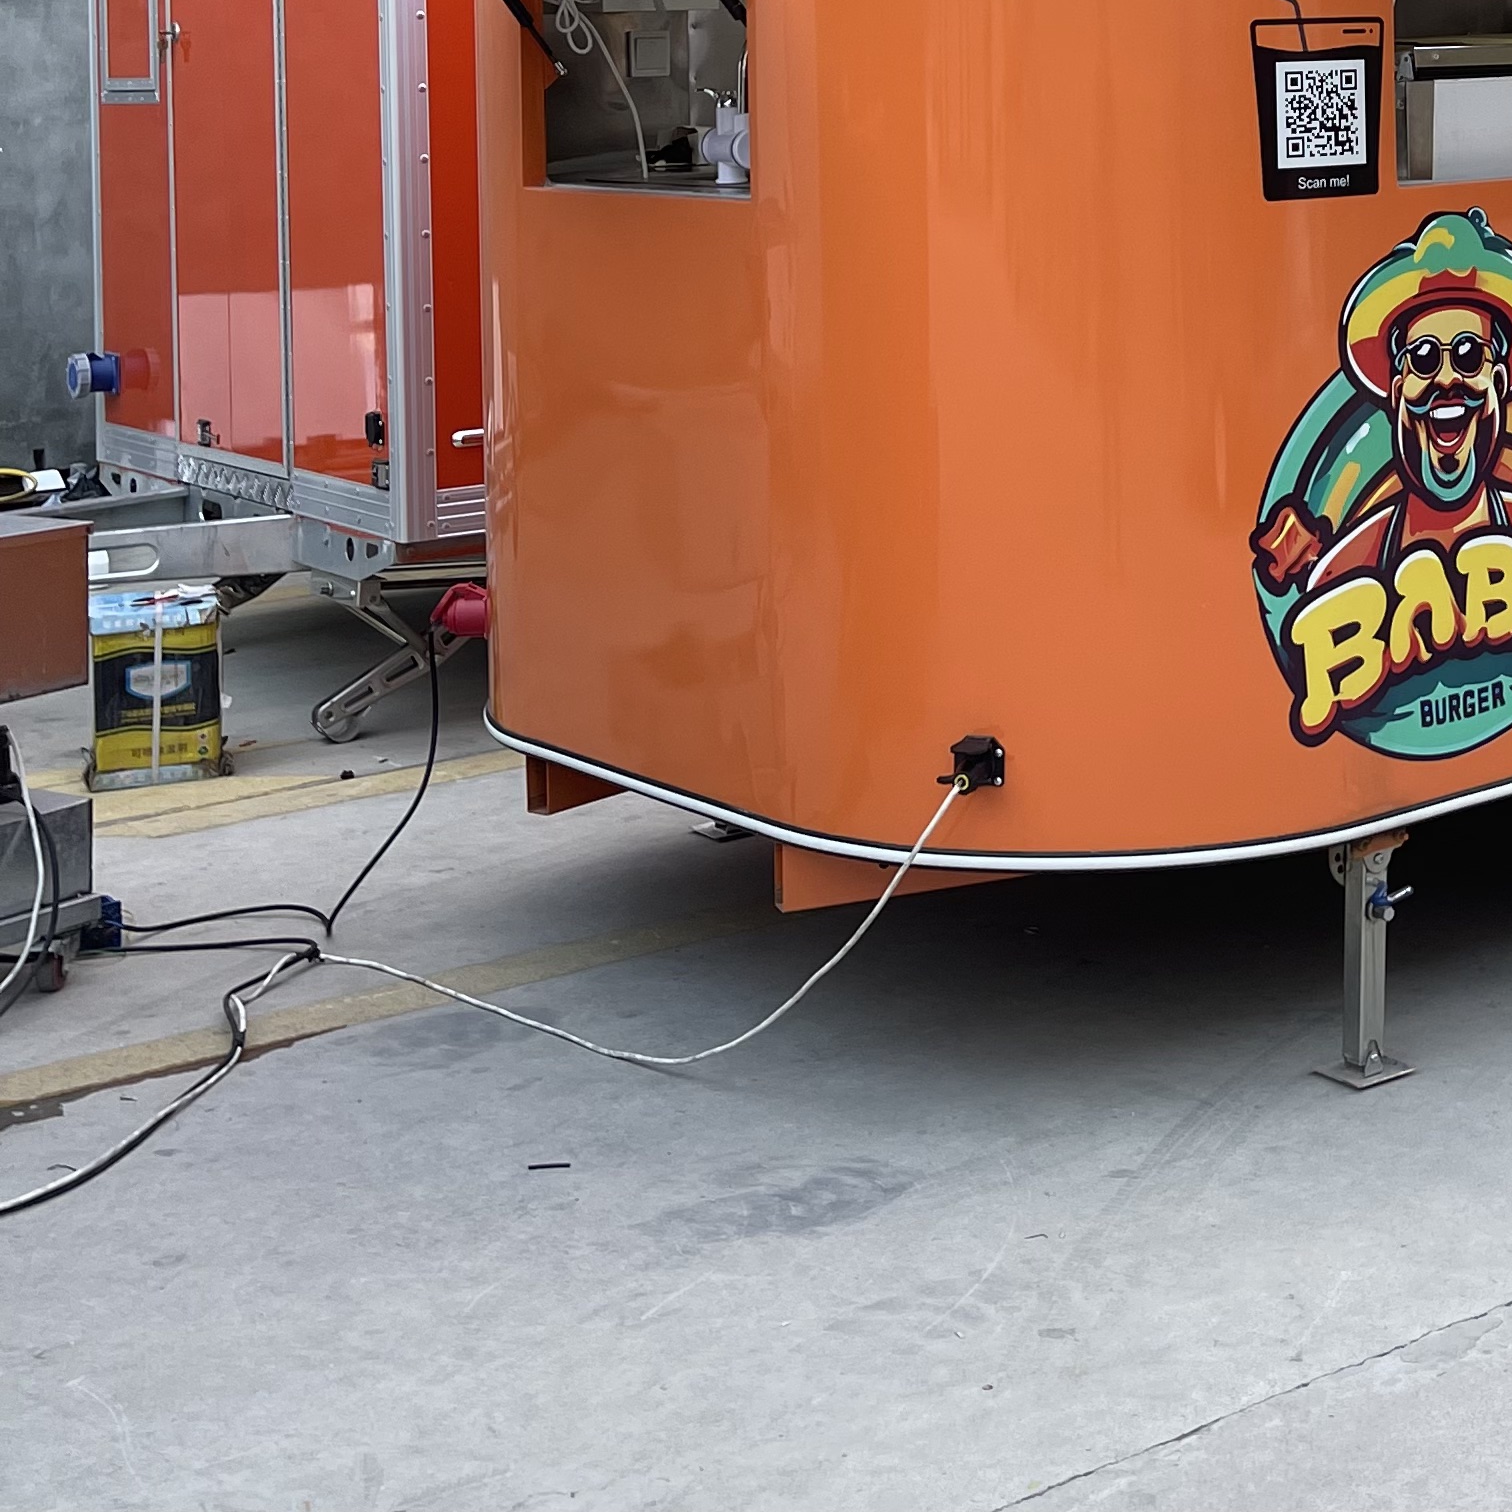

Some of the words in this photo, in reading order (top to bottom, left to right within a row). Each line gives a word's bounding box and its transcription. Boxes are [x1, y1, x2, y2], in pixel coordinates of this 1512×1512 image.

[1298, 176, 1327, 189] Scan
[1329, 174, 1350, 187] me!
[1419, 680, 1507, 729] BURGER
